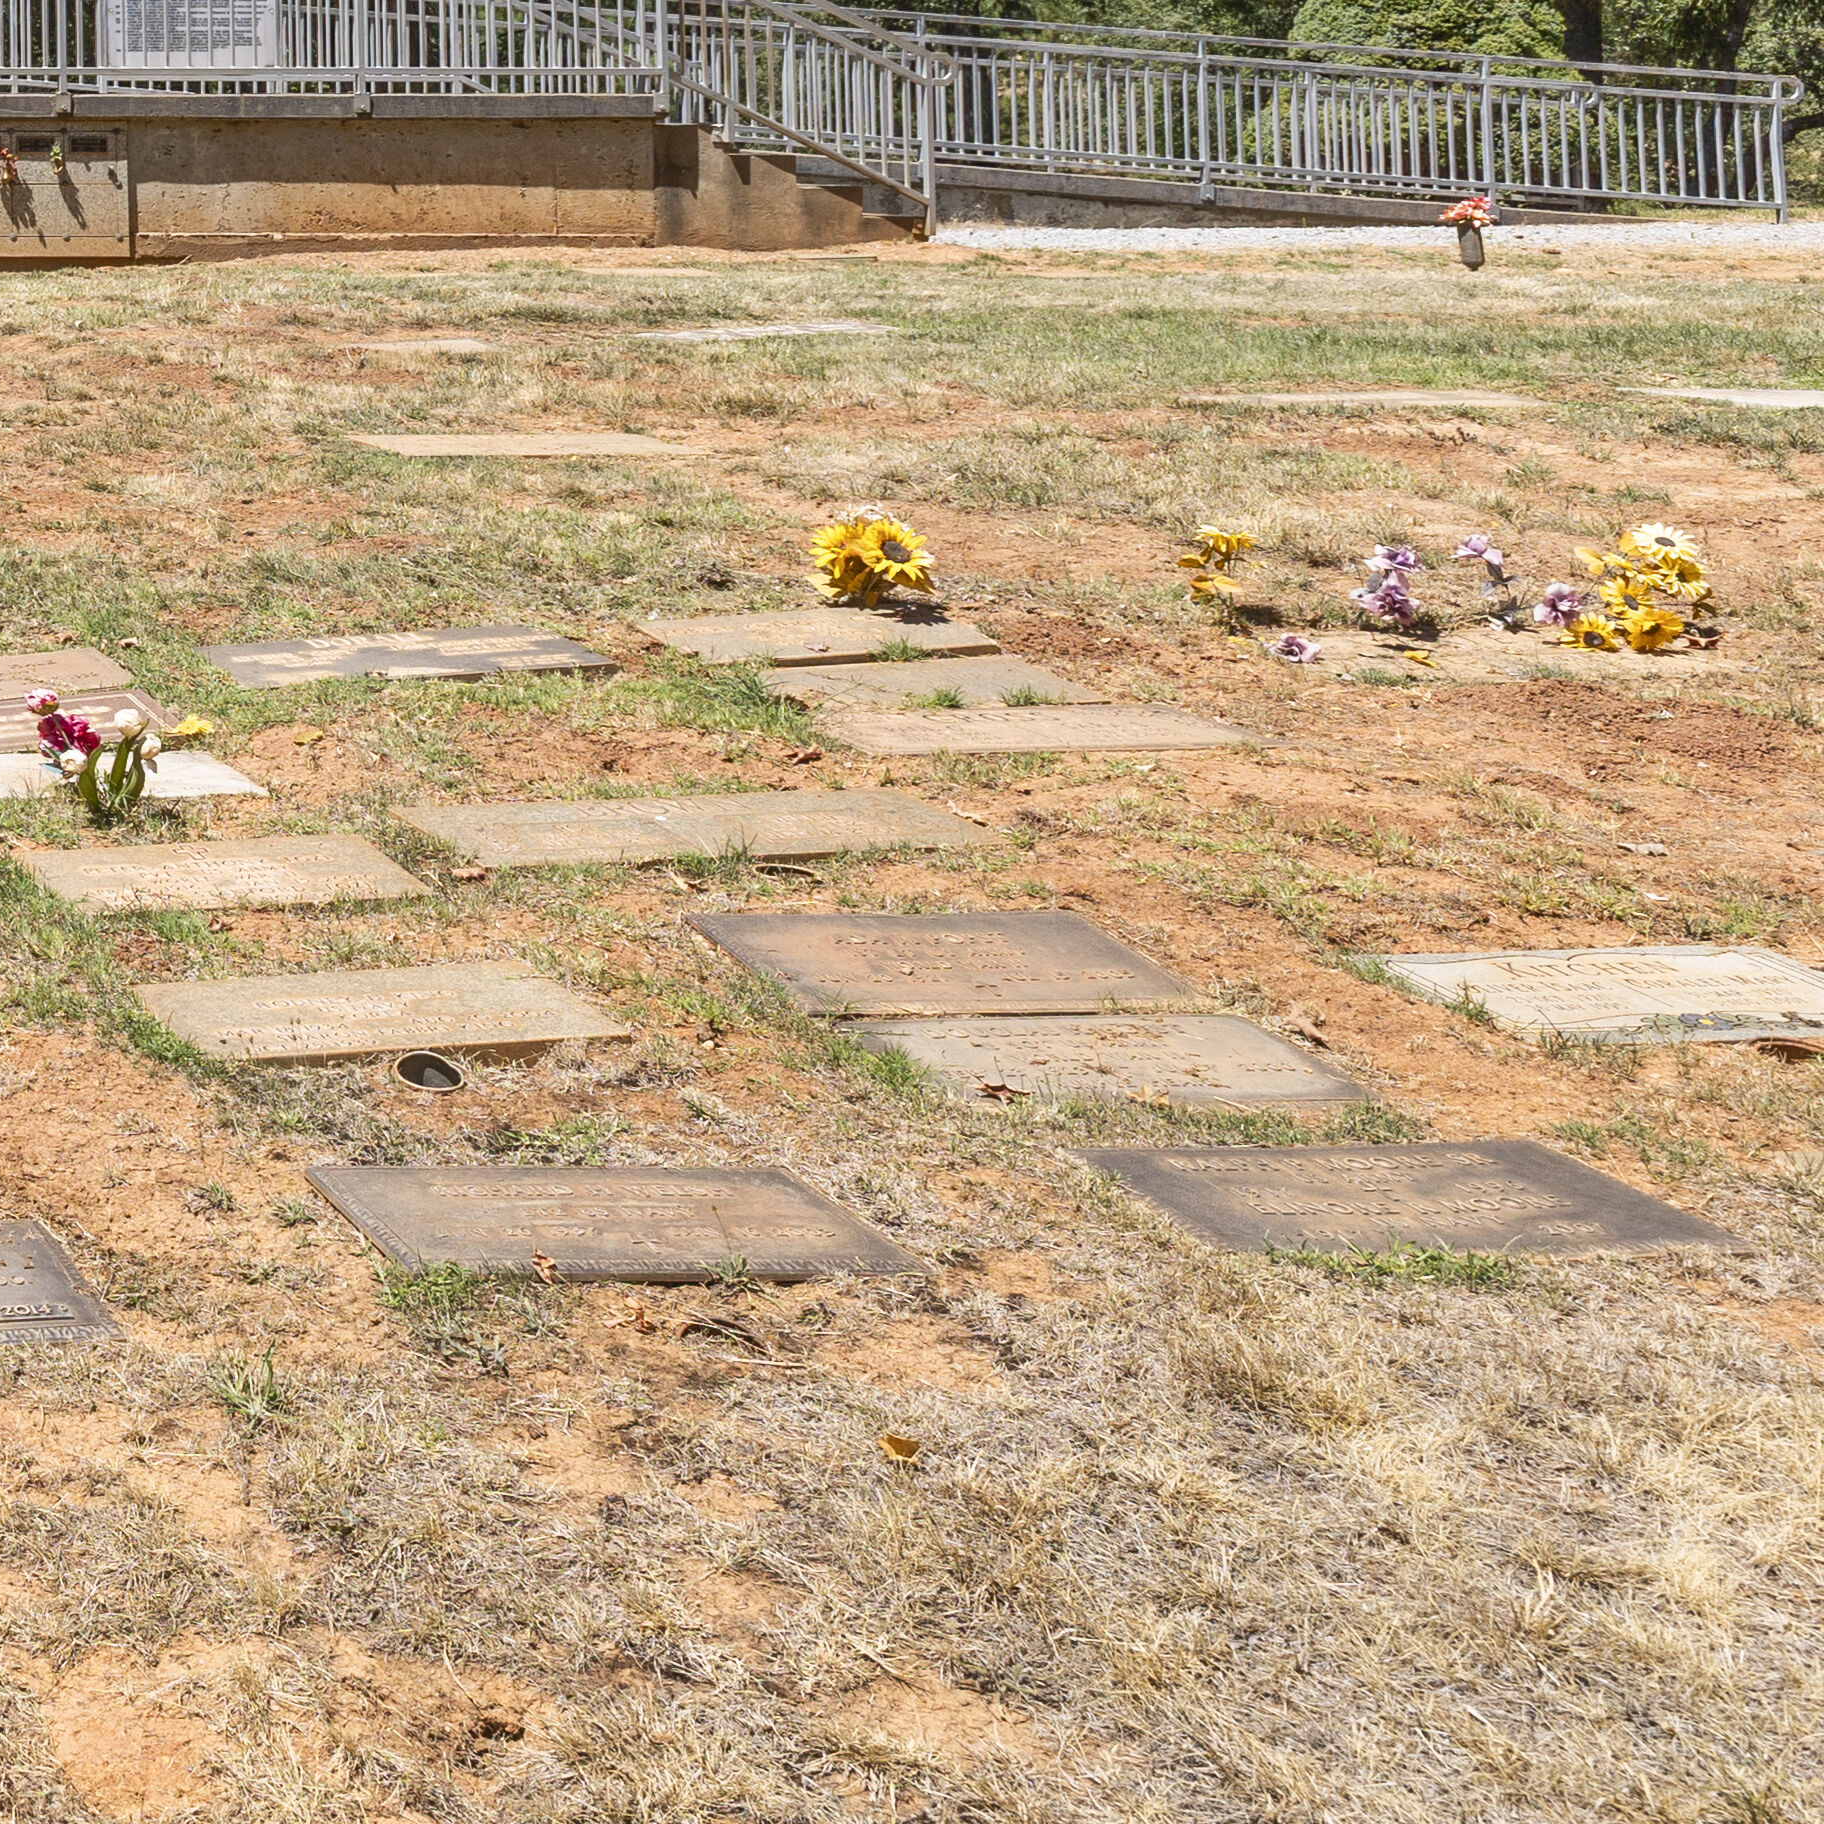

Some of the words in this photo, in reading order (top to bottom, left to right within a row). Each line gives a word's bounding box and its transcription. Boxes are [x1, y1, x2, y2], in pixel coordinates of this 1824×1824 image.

[1494, 958, 1681, 978] KITCHEN
[1541, 980, 1613, 991] ISAAC
[1167, 1157, 1277, 1172] RALPH
[1312, 1154, 1444, 1171] MOORE
[1444, 1151, 1497, 1166] SR
[430, 1184, 578, 1198] RICHARD
[621, 1184, 734, 1198] WELSH
[578, 1206, 612, 1218] US
[619, 1206, 699, 1218] NAVY
[1248, 1201, 1400, 1216] ELINORE
[1435, 1195, 1583, 1214] MOORE
[1417, 1214, 1511, 1228] NAVY
[0, 1304, 57, 1319] 2014
